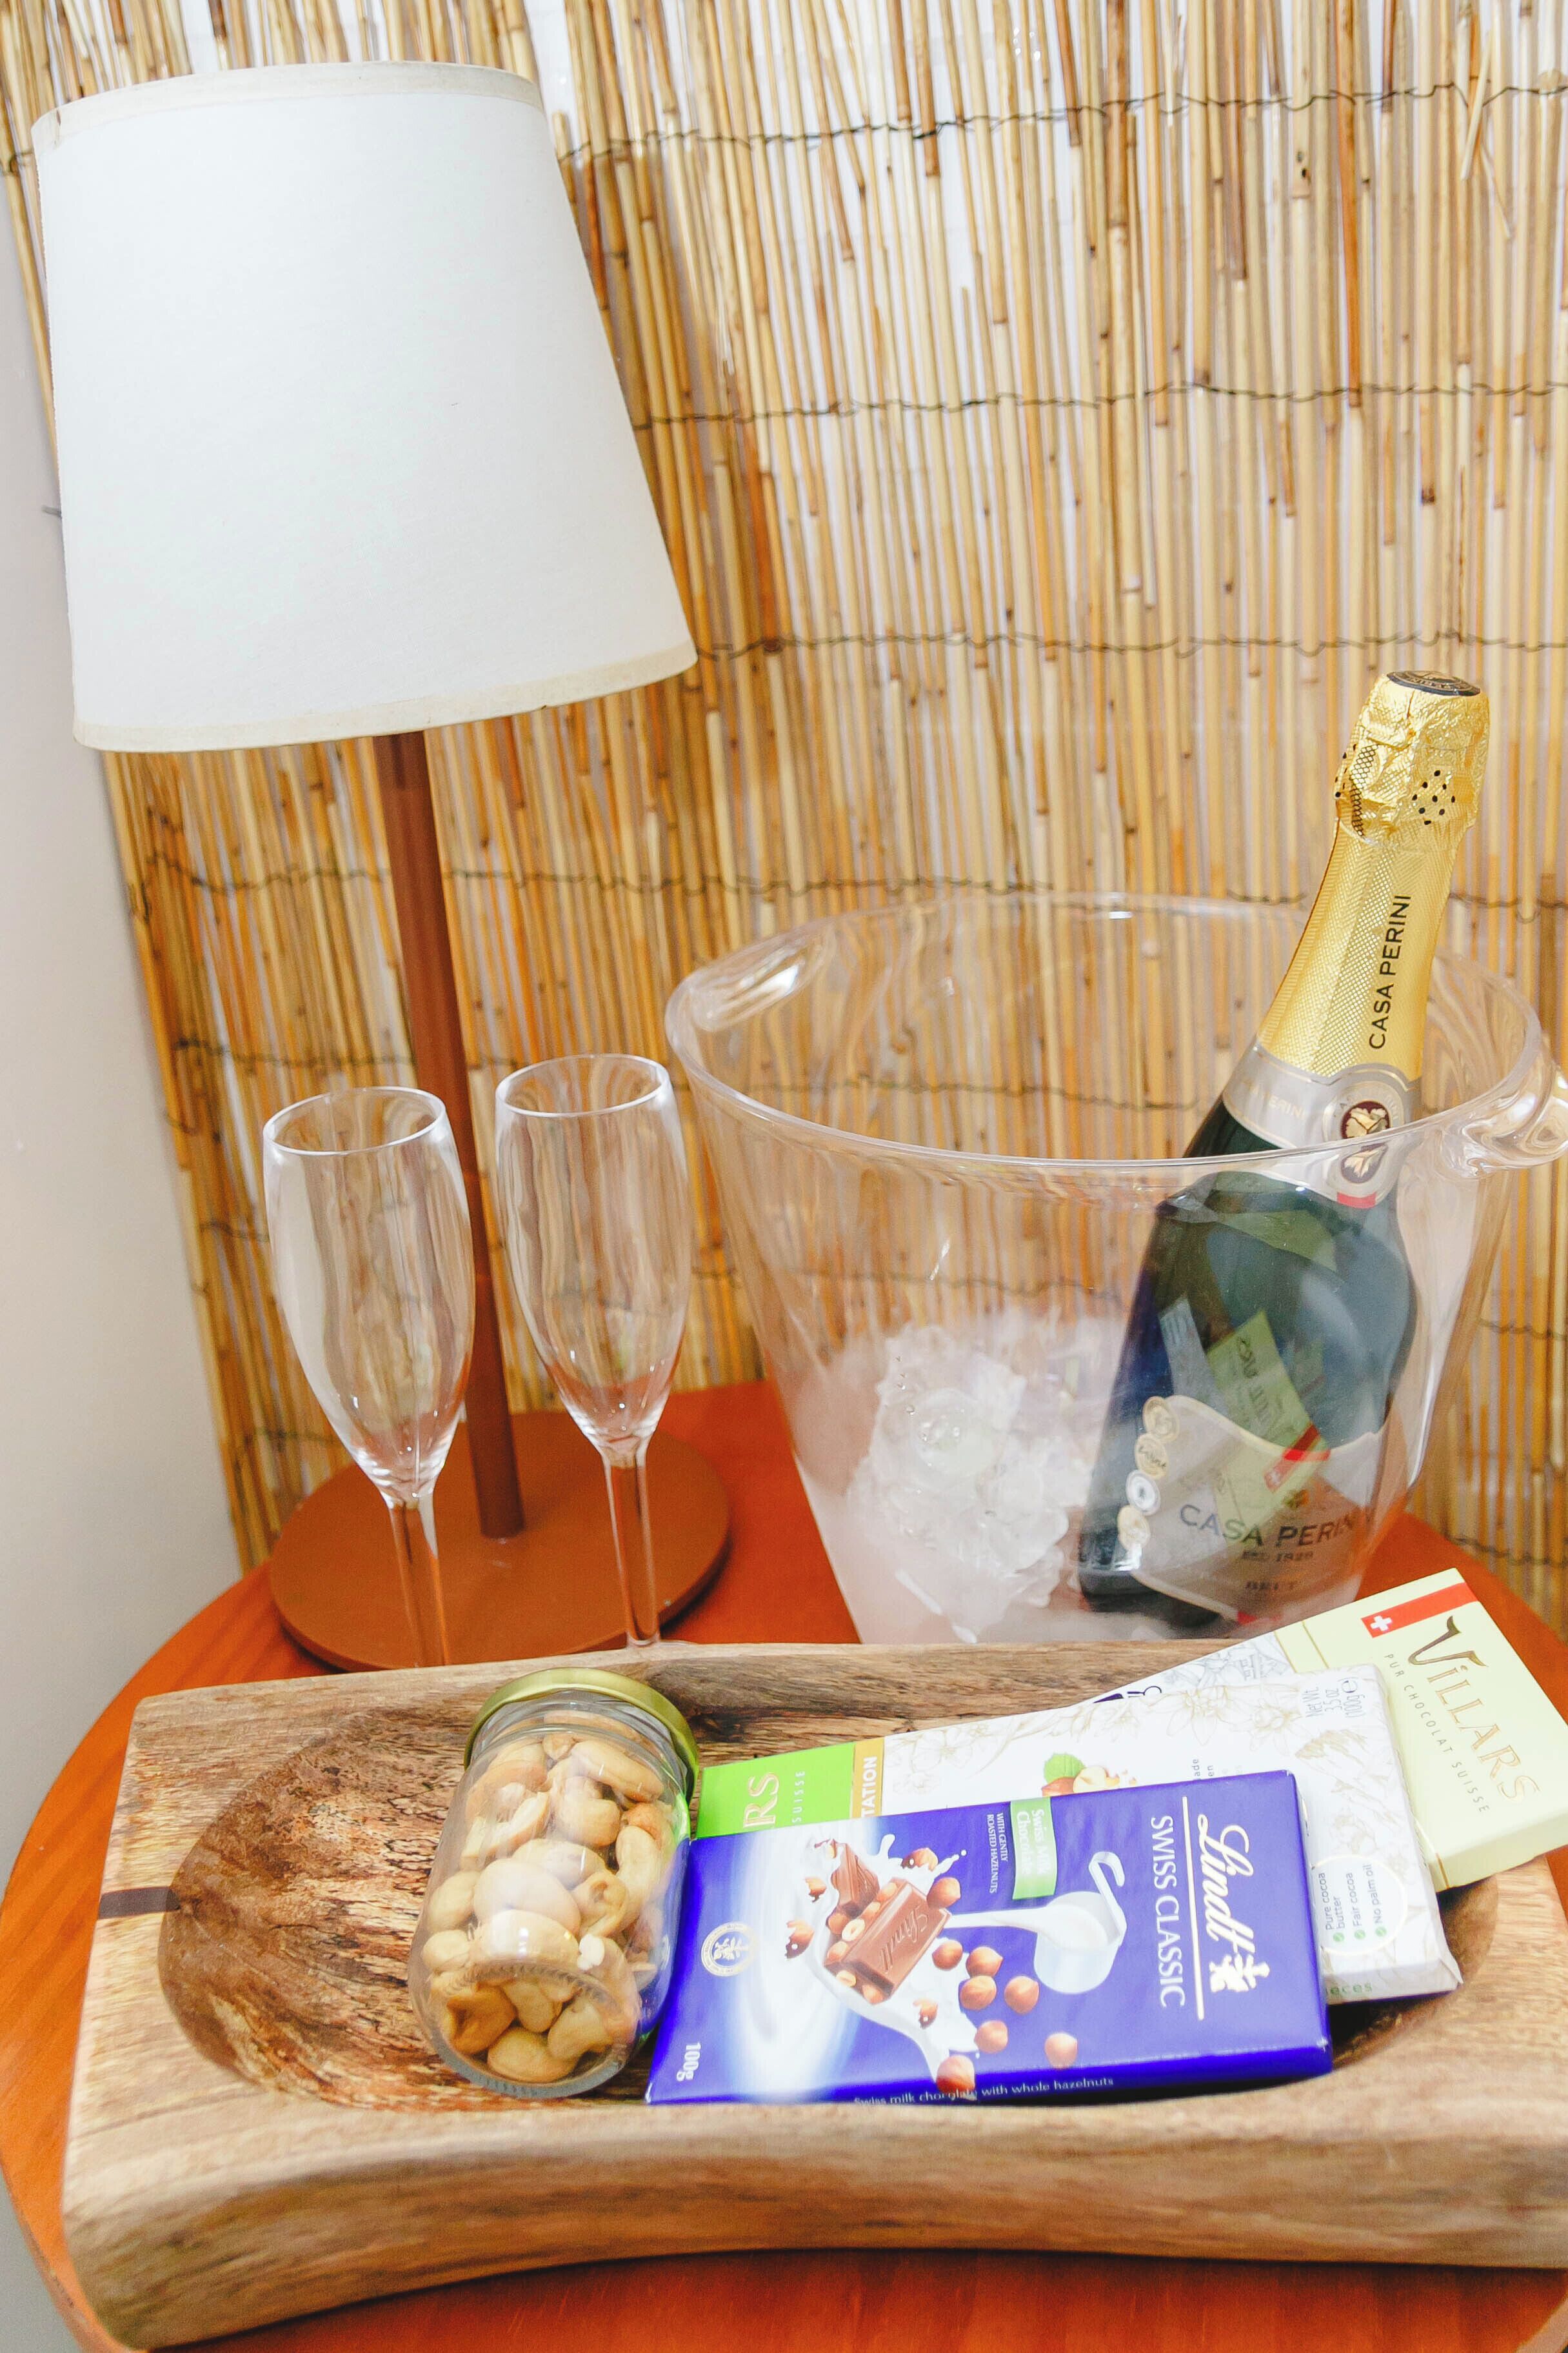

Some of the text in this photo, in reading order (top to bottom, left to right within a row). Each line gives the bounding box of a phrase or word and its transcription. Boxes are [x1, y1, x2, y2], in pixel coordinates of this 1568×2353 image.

[1369, 894, 1411, 1050] CASA PERINI
[1180, 1504, 1264, 1547] CASA
[1325, 1688, 1340, 1698] oz
[1384, 1653, 1490, 1813] PUR CHOCOLAT SUISSE
[792, 1770, 806, 1823] SUISSE
[996, 1812, 1009, 1862] WITH GENTLY
[1017, 1810, 1034, 1875] Chocolate
[1031, 1808, 1047, 1843] Swiss
[986, 1814, 999, 1894] ROASTED HAZELNUTS
[1198, 1812, 1255, 1956] Lindt
[1318, 1872, 1335, 1930] Pure cocoa
[1345, 1872, 1362, 1927] Fair cocoa
[1362, 1863, 1383, 1924] No palm oil
[1150, 1816, 1186, 2008] SWISS CLASSIC
[1333, 1896, 1345, 1929] butter
[676, 2041, 702, 2083] 100g
[889, 2092, 915, 2105] milk
[982, 2084, 1008, 2096] with
[1011, 2081, 1050, 2094] whole
[1053, 2077, 1115, 2090] hazelnuts
